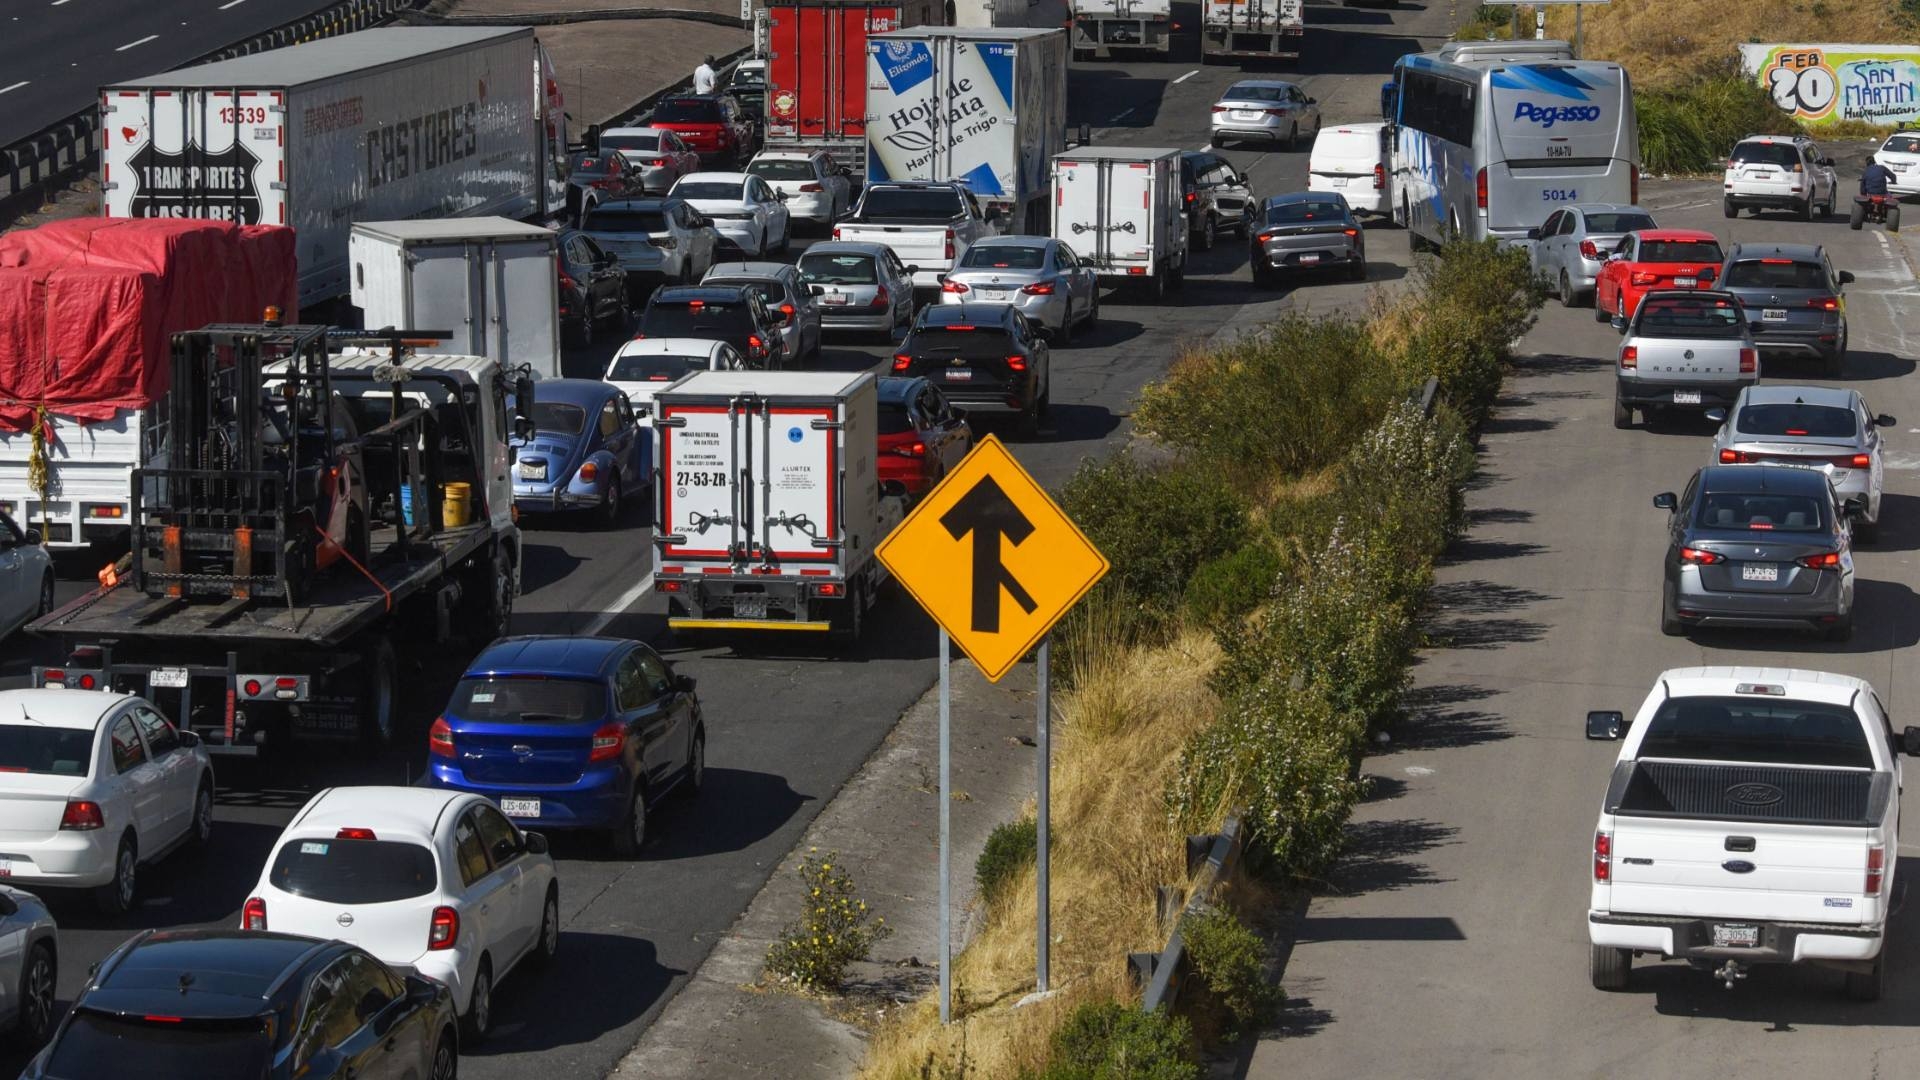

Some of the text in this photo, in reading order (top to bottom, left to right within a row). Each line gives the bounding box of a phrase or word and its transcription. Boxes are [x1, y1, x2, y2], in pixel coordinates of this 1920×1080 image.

[888, 52, 928, 78] Elizondo
[1780, 53, 1819, 67] FEB
[1769, 67, 1835, 115] 20
[1845, 82, 1914, 106] MARTIN
[219, 107, 266, 124] 13539
[889, 77, 973, 131] Hoja de
[924, 95, 985, 135] Plata
[1514, 102, 1600, 128] Pegasso
[1844, 104, 1918, 123] Huixquilucan
[367, 102, 476, 189] CASTORES
[905, 115, 998, 172] Harina de Trigo
[144, 166, 246, 190] TRANSPORTES
[1542, 189, 1577, 201] 5014
[676, 471, 726, 487] 27-53-ZR
